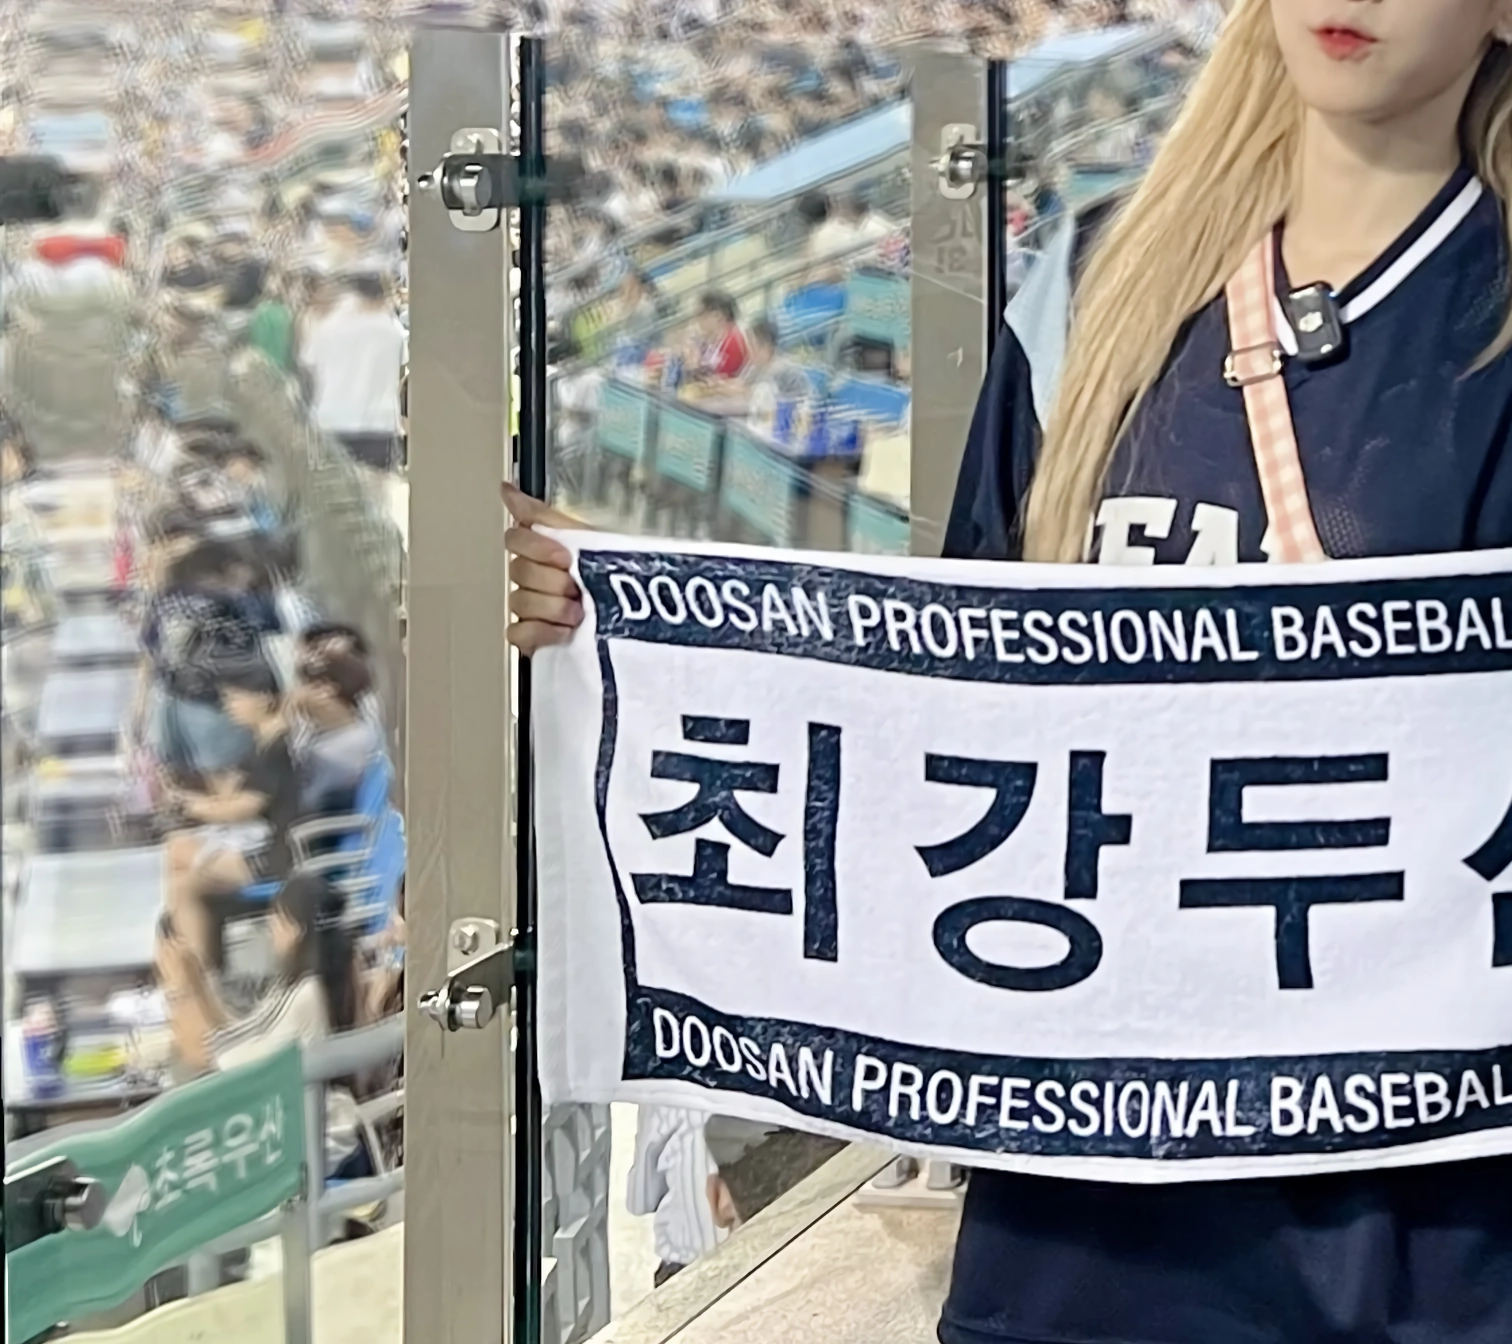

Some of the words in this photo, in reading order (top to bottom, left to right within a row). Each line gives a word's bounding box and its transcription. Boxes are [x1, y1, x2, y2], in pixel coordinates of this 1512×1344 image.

[608, 571, 833, 642] DOOSAN
[847, 593, 1259, 664] PROFESSIONAL
[653, 1006, 834, 1106] DOOSAN
[851, 1062, 1258, 1138] PROFESSIONAL
[154, 1093, 286, 1210] 초록우산
